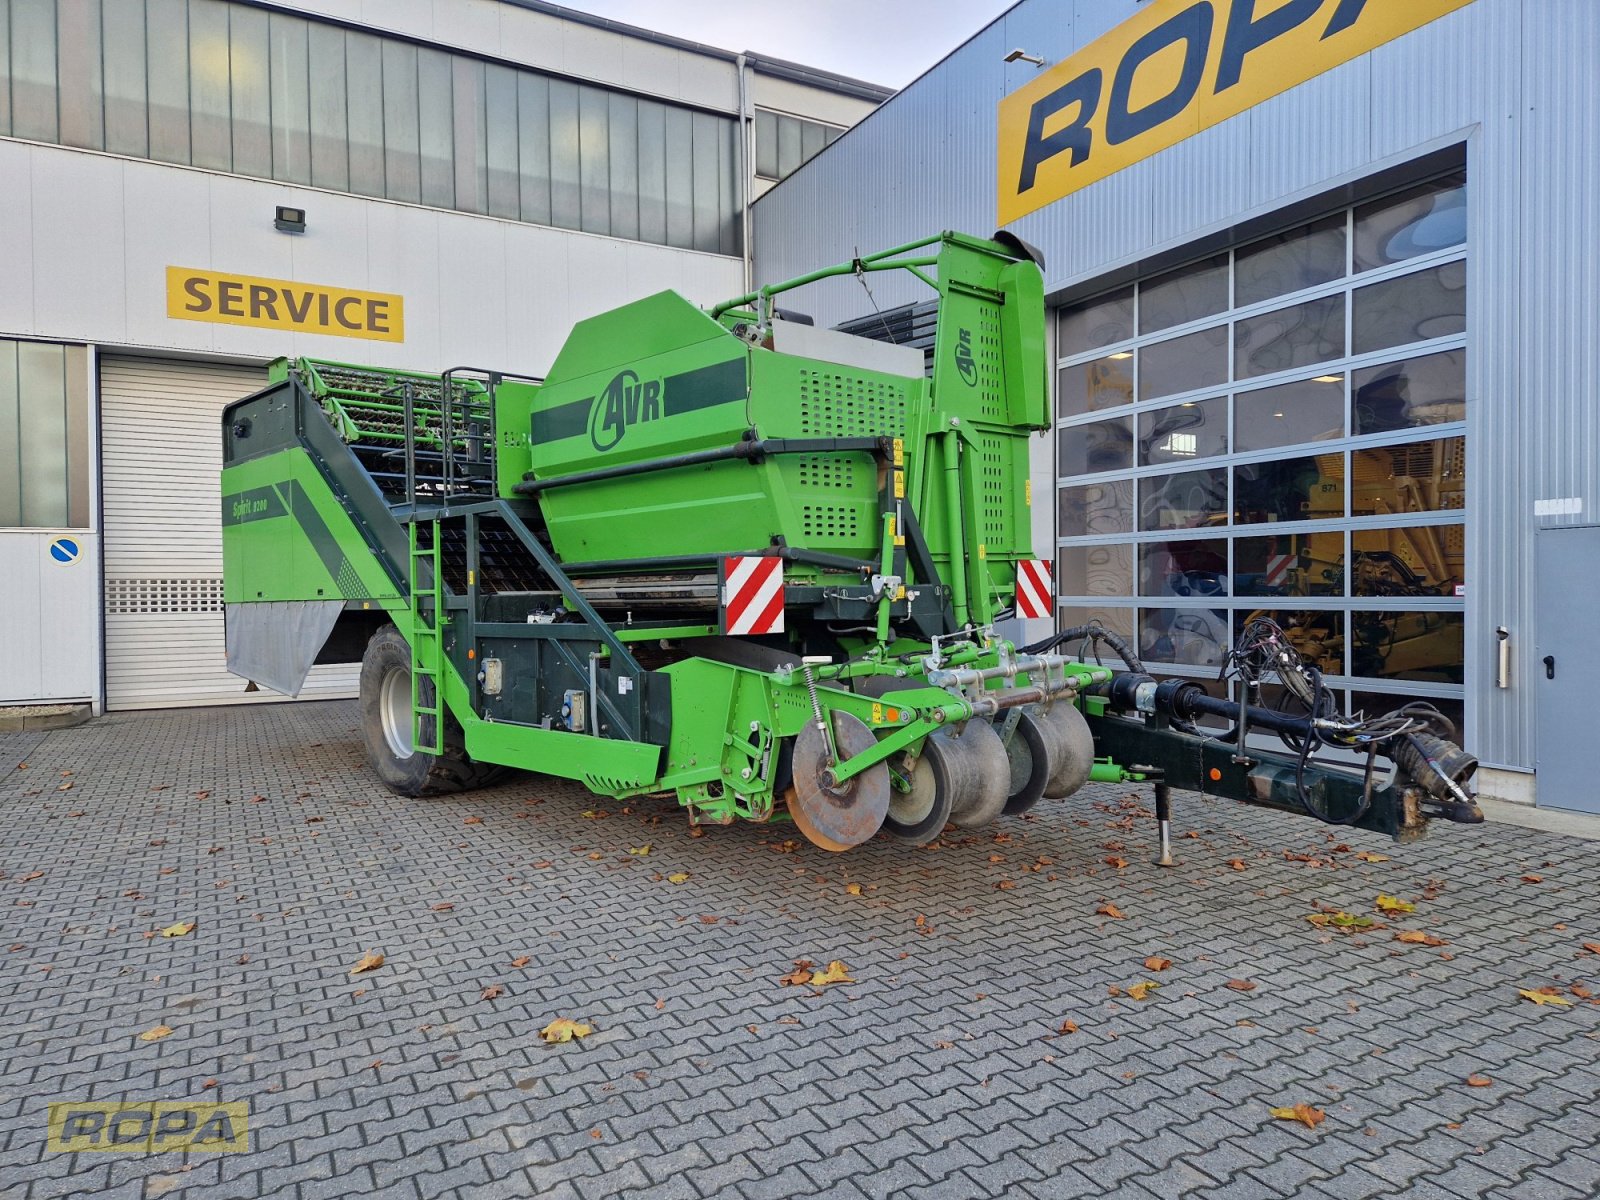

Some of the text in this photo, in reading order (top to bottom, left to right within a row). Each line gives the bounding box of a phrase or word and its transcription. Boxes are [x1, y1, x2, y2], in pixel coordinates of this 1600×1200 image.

[1017, 0, 1368, 195] ROP
[183, 277, 390, 333] SERVICE
[954, 327, 978, 387] AVR
[591, 369, 661, 452] AVR
[233, 499, 251, 520] Spirit
